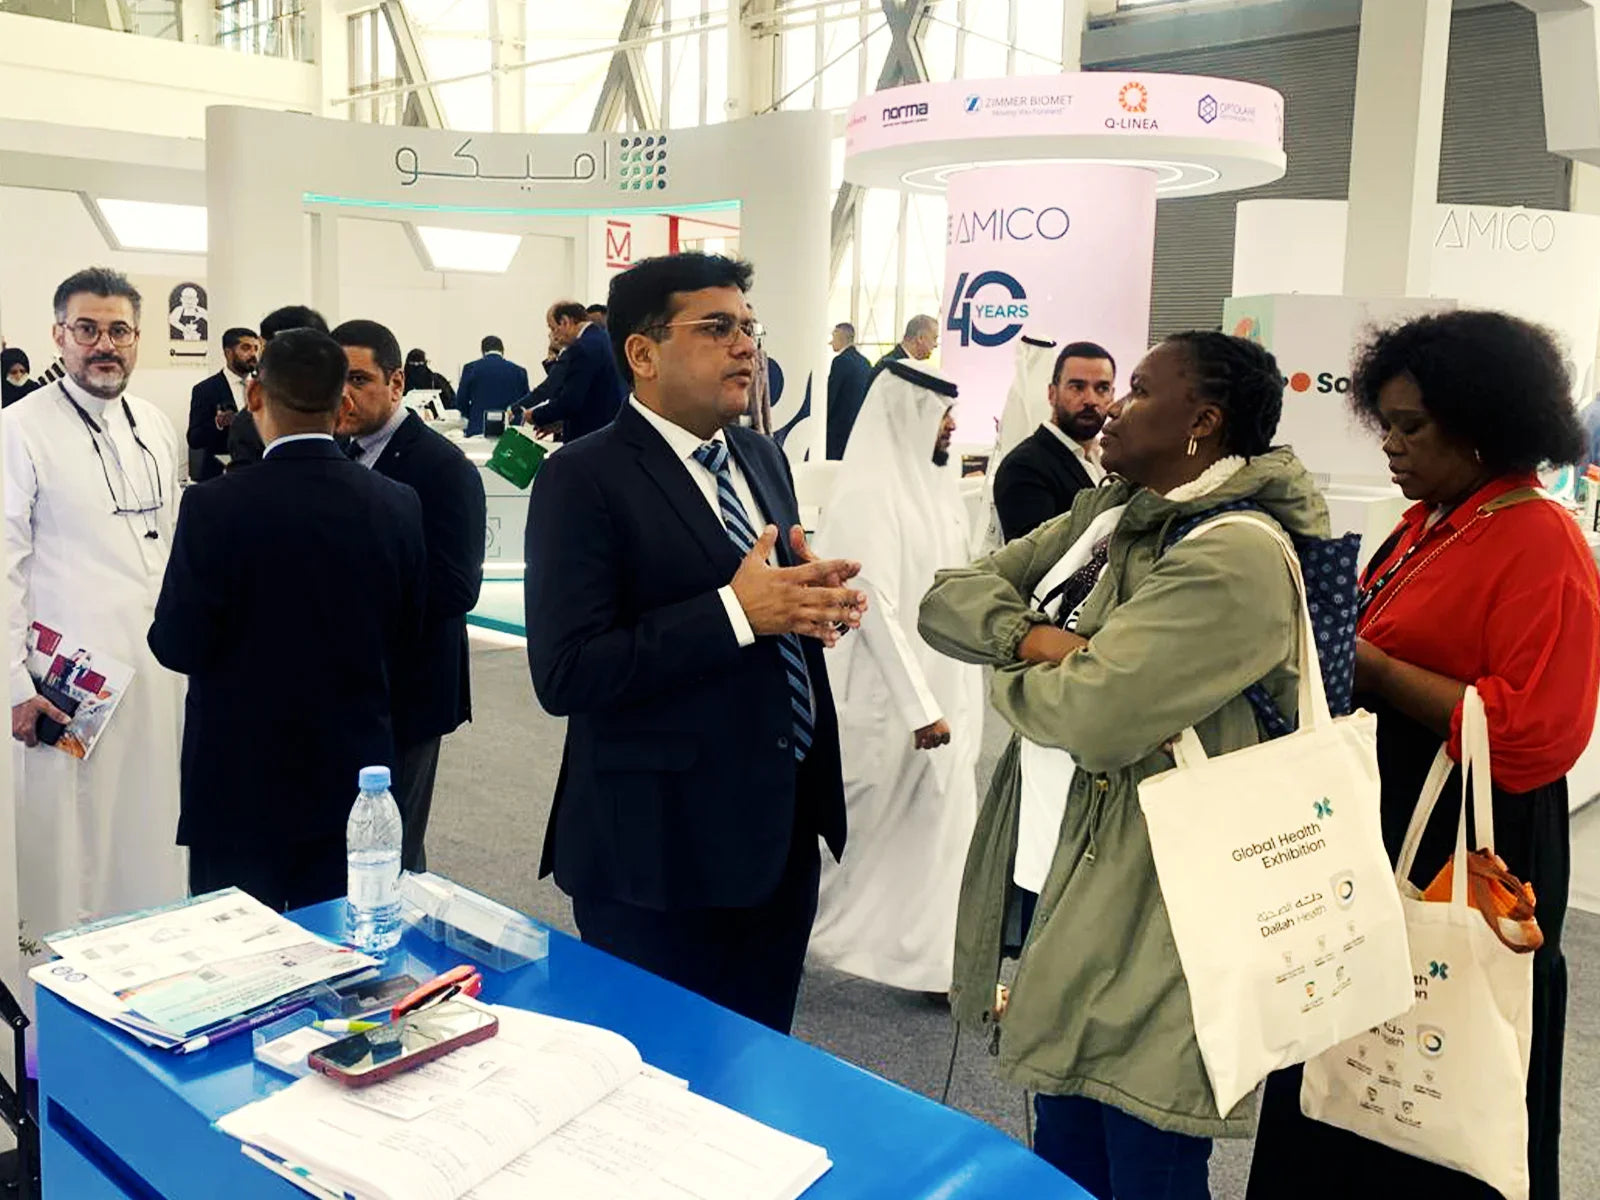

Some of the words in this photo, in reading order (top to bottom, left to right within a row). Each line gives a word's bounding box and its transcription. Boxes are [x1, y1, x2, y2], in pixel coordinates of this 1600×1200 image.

[882, 102, 929, 122] norma
[986, 97, 1027, 108] ZIMMER
[1030, 94, 1073, 106] BIOMET
[1104, 117, 1159, 129] Q-LINEA
[956, 206, 1070, 244] AMICO
[1434, 204, 1556, 252] AMICO
[946, 270, 1027, 347] 40
[975, 304, 1029, 319] YEARS
[1231, 837, 1276, 862] Global
[1278, 822, 1321, 847] Health
[1261, 838, 1326, 869] Exhibition
[1260, 918, 1295, 938] Dallah
